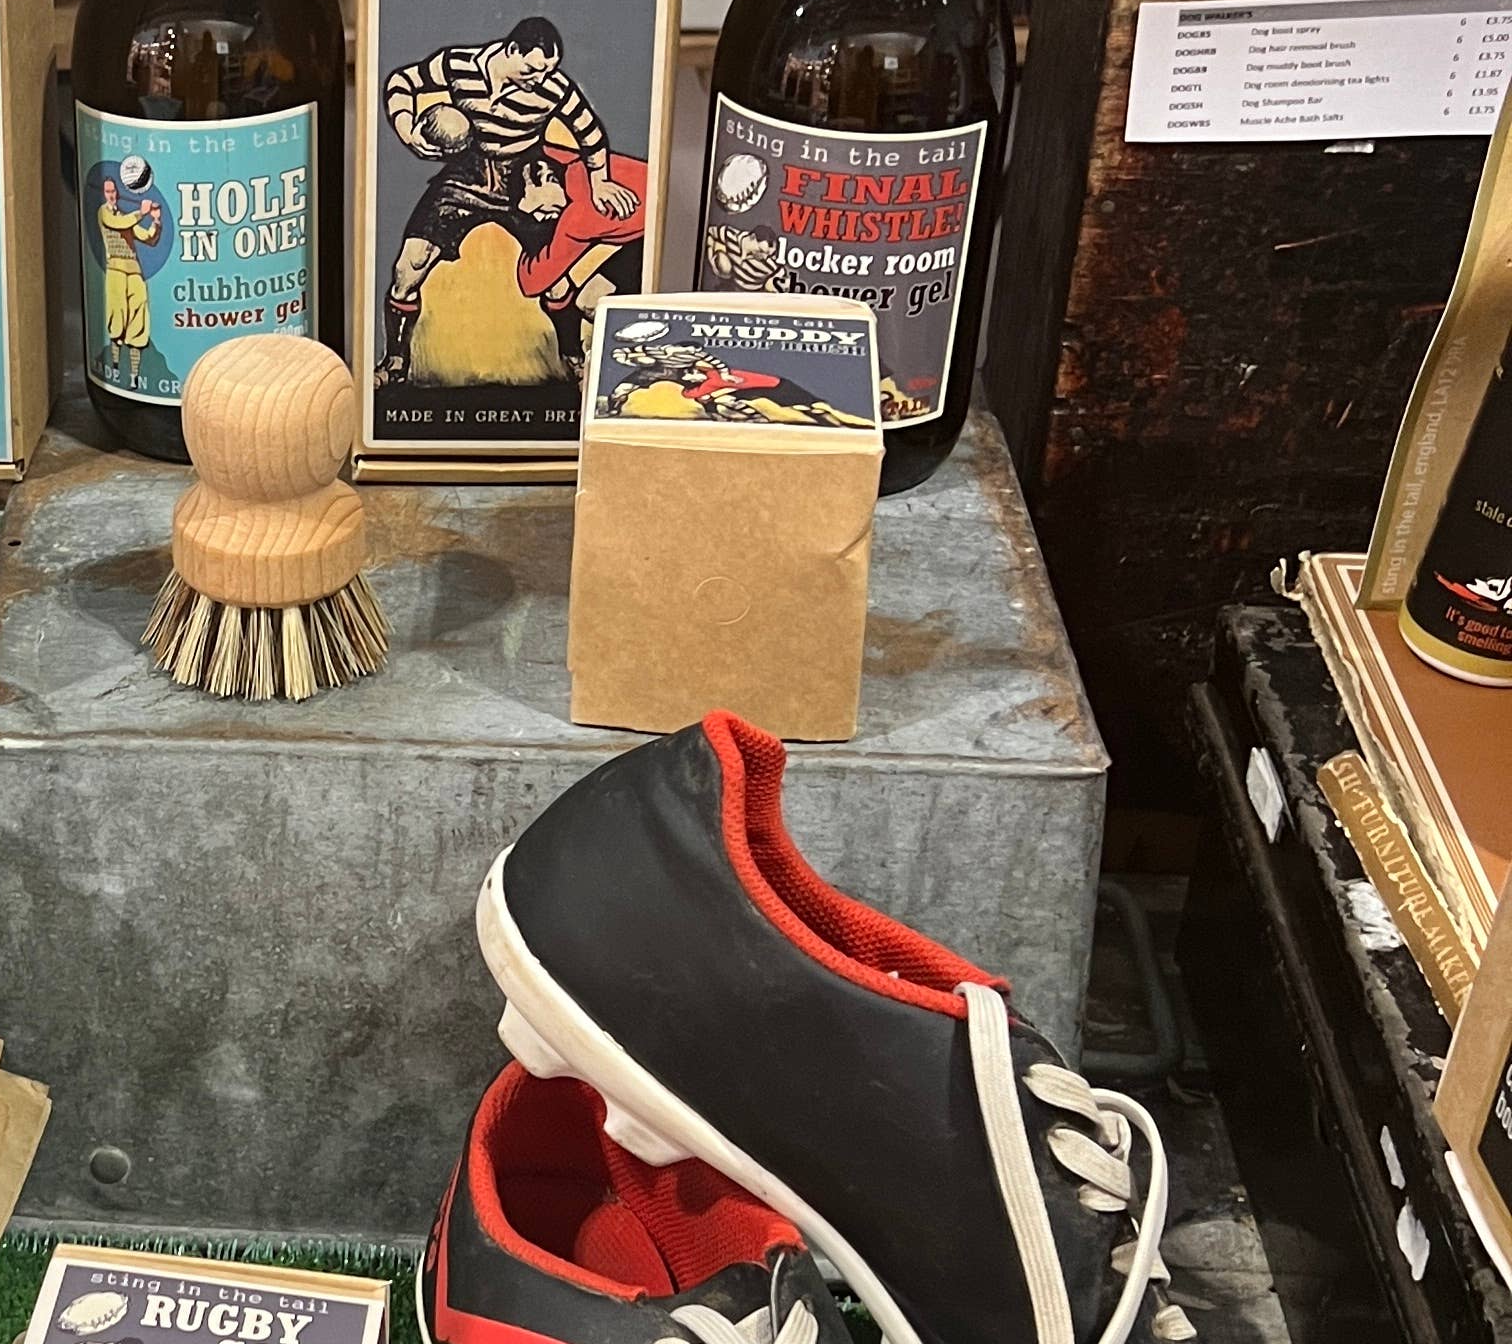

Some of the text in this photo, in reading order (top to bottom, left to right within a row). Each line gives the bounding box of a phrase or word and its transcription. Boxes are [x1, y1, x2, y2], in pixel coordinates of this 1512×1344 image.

[177, 165, 307, 226] HOLE
[783, 163, 969, 205] FINAL
[179, 214, 307, 262] IN ONE!
[777, 201, 965, 243] WHISTLE!
[776, 237, 956, 277] locker room
[173, 265, 308, 303] clubhouse
[909, 275, 953, 318] gel
[174, 292, 307, 328] shower gel
[690, 323, 865, 345] MUDDY
[704, 338, 774, 351] BOOT
[1430, 367, 1457, 406] LA12
[386, 410, 534, 423] MADE IN GREAT
[1414, 409, 1445, 476] england,
[1403, 479, 1425, 506] tail,
[1394, 509, 1415, 536] the
[1475, 500, 1505, 524] stale
[1390, 539, 1407, 554] in
[1380, 557, 1406, 594] sting
[1445, 606, 1500, 636] It's good
[1351, 792, 1434, 930] FURNITURE
[90, 1271, 329, 1315] sting in the tail
